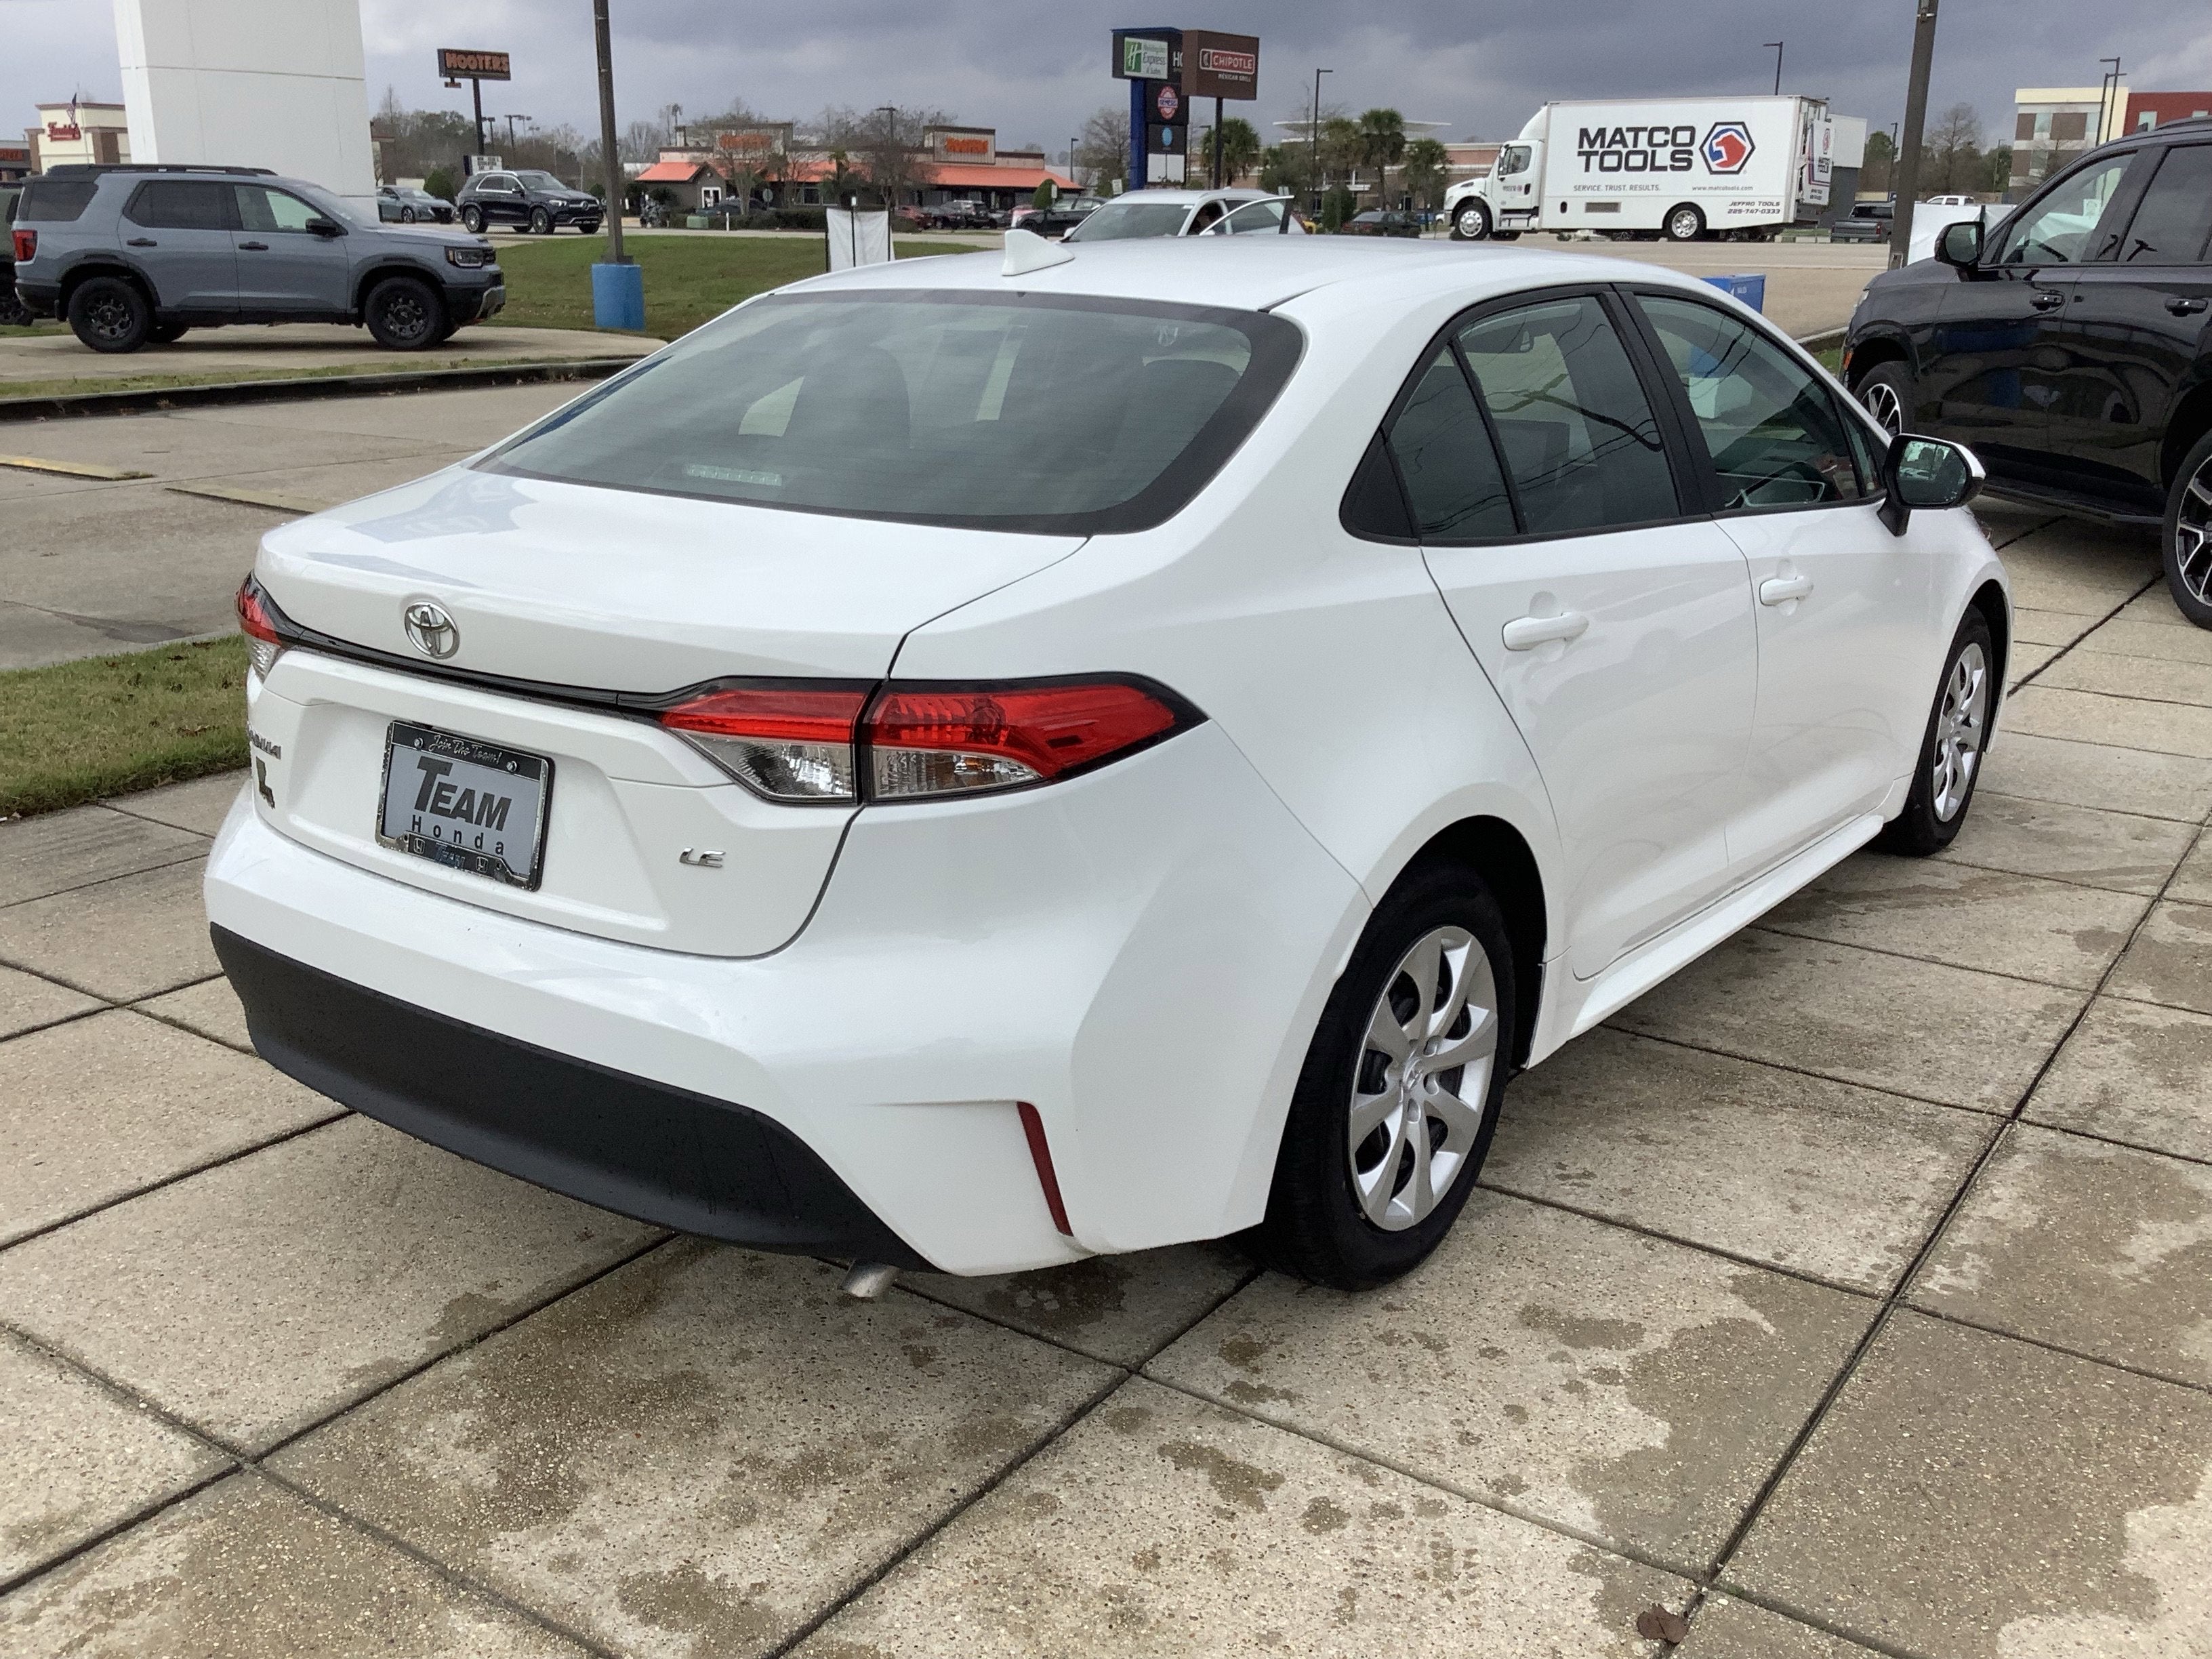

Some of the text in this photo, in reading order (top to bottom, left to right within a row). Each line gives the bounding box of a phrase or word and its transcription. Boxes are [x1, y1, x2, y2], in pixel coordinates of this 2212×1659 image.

[445, 52, 509, 73] HOOTERS
[1212, 55, 1253, 70] CHIPOTLE
[1578, 125, 1696, 149] MATCO
[1577, 149, 1694, 173] TOOLS
[428, 735, 503, 764] Join The Team!
[414, 756, 512, 832] TEAM
[411, 814, 504, 856] Honda
[679, 847, 726, 868] LE
